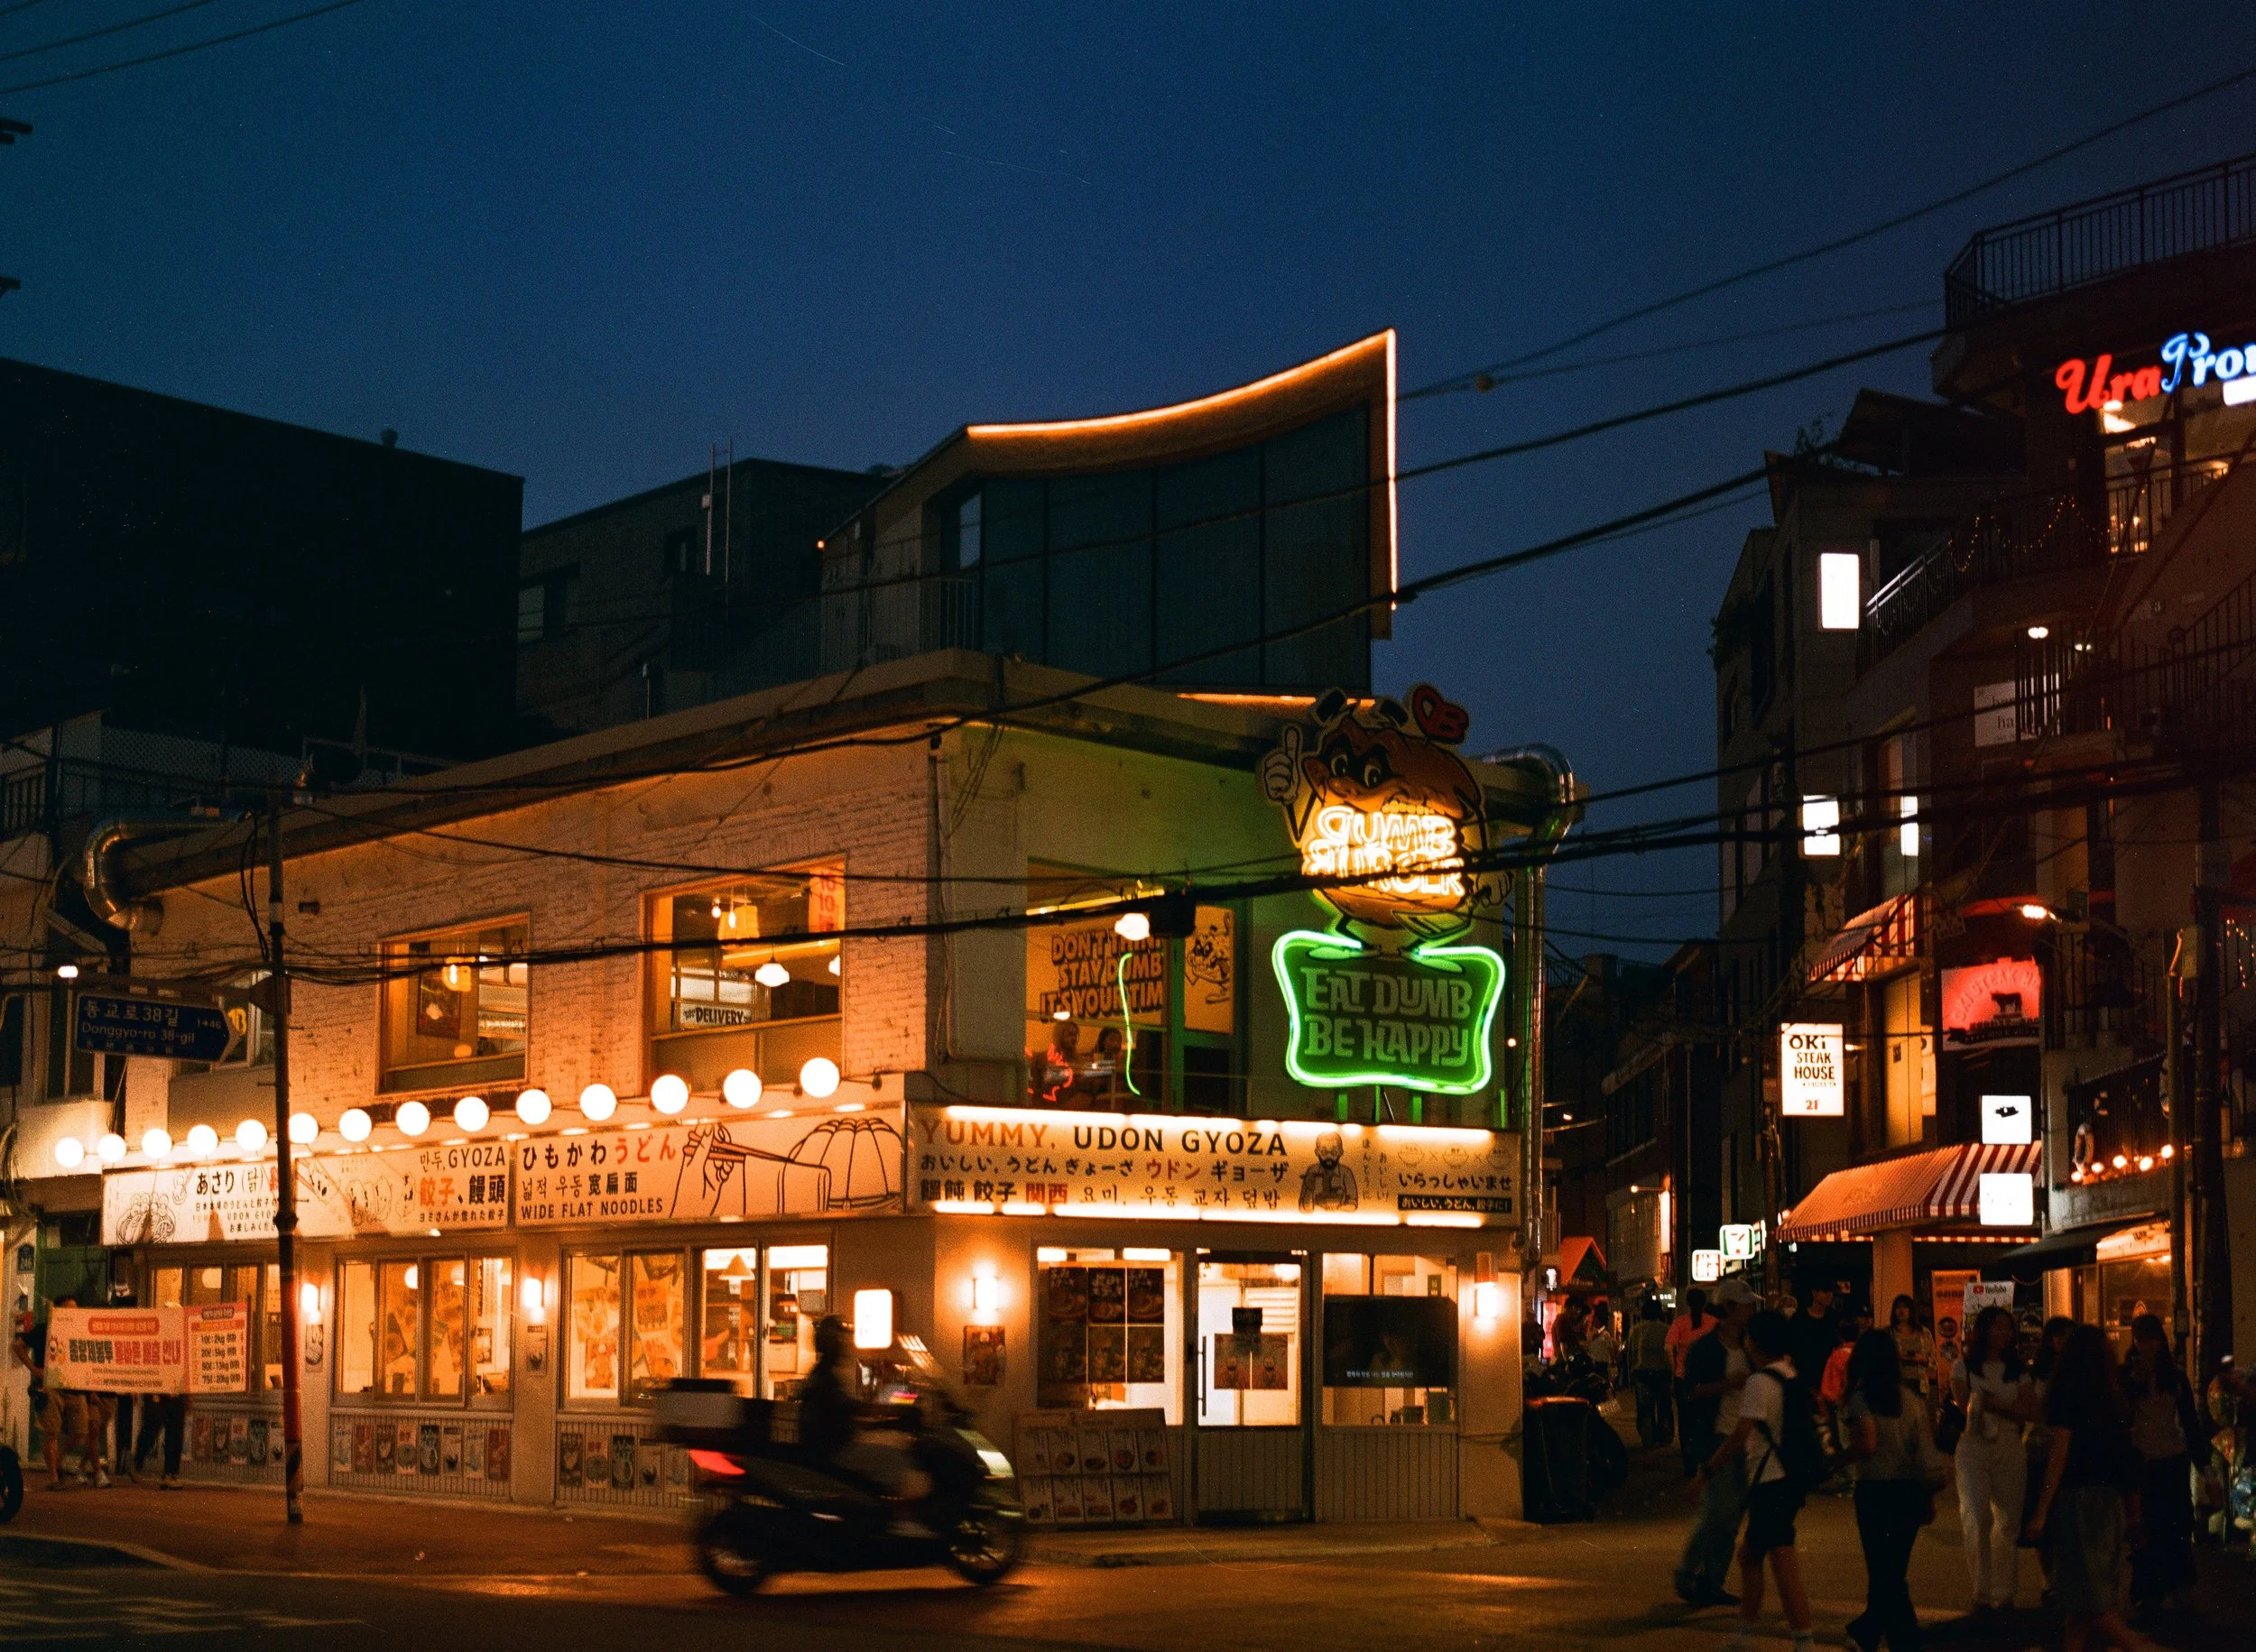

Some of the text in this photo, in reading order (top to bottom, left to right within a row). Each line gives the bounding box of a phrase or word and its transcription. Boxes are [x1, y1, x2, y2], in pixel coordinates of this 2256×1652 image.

[1059, 956, 1104, 989] STAY
[1300, 967, 1473, 1020] EAT DUMB
[83, 999, 180, 1028] 동교로38길
[695, 1006, 744, 1026] DELIVERY
[81, 1021, 196, 1045] Donggyo-ro 38-gil
[1304, 1014, 1470, 1067] BE HAPPY
[1796, 1052, 1832, 1064] STEAK
[1794, 1066, 1835, 1080] HOUSE
[522, 1133, 677, 1171] ひもかわうどん
[1074, 1125, 1164, 1152] UDON
[1181, 1130, 1288, 1156] GYOZA
[448, 1145, 506, 1169] GYOZA
[196, 1169, 235, 1195] あさり
[1146, 1158, 1201, 1181] ウドン
[1210, 1159, 1290, 1184] ギョーザ
[1399, 1172, 1512, 1191] いらっしゃいませ
[555, 1175, 583, 1199] 우동
[973, 1179, 1018, 1203] 餃子
[1140, 1185, 1179, 1207] 우동
[1191, 1186, 1231, 1208] 교자
[521, 1197, 663, 1220] WIDE FLAT NOODLES
